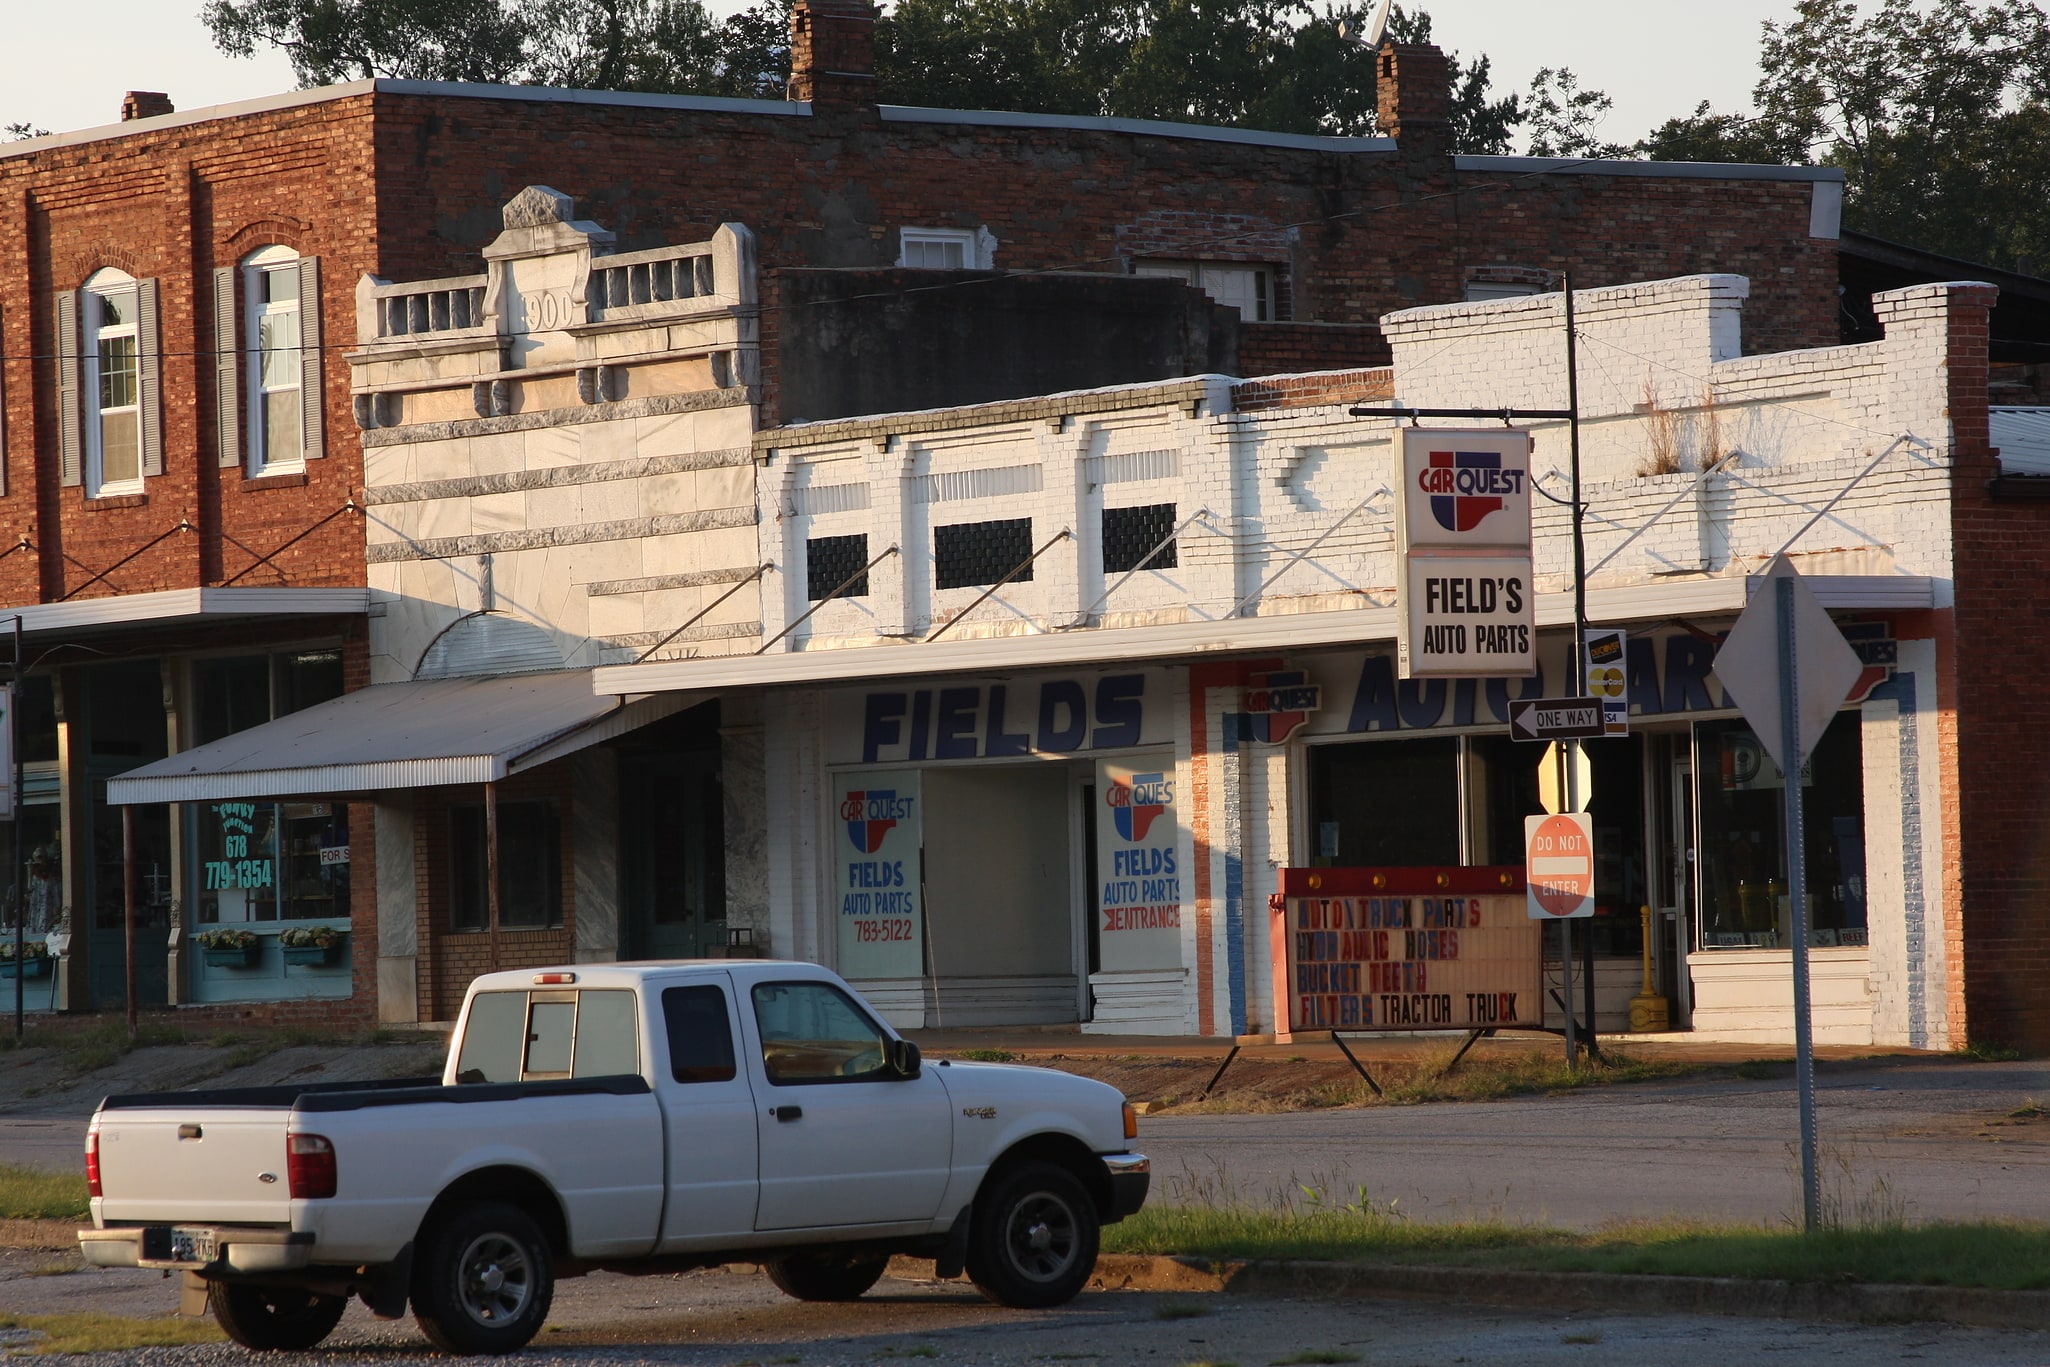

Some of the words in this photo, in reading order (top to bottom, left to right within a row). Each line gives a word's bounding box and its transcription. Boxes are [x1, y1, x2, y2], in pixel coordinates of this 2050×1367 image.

[1426, 577, 1523, 614] FIELD'S
[1423, 624, 1467, 654] AUTO
[1475, 624, 1529, 654] PARTS
[862, 674, 1145, 763] FIELDS
[1536, 710, 1561, 727] ONE
[1566, 709, 1594, 726] WAY
[1106, 786, 1131, 807] CAR
[1134, 781, 1176, 805] QUES
[840, 800, 863, 821] CAR
[868, 797, 914, 820] QUEST
[225, 834, 247, 858] 678
[321, 849, 341, 862] FOR
[1537, 836, 1553, 851] DO
[1559, 835, 1582, 851] NOT
[205, 859, 272, 889] 779-1354
[849, 860, 904, 888] FIELDS
[1114, 847, 1176, 877] FIELDS
[1103, 881, 1137, 905] AUTO
[1542, 880, 1579, 897] ENTER
[842, 893, 871, 916] AUTO
[875, 891, 913, 915] PARTS
[1423, 899, 1481, 928] PARTS
[1116, 904, 1181, 931] ENTRANCE
[1405, 930, 1459, 961] HOSES
[1296, 963, 1361, 993] BUCKET
[1369, 962, 1427, 993] TEETH
[1301, 995, 1373, 1025] FILTERS
[1380, 994, 1452, 1024] TRACTOR
[1466, 992, 1518, 1023] TRUCK
